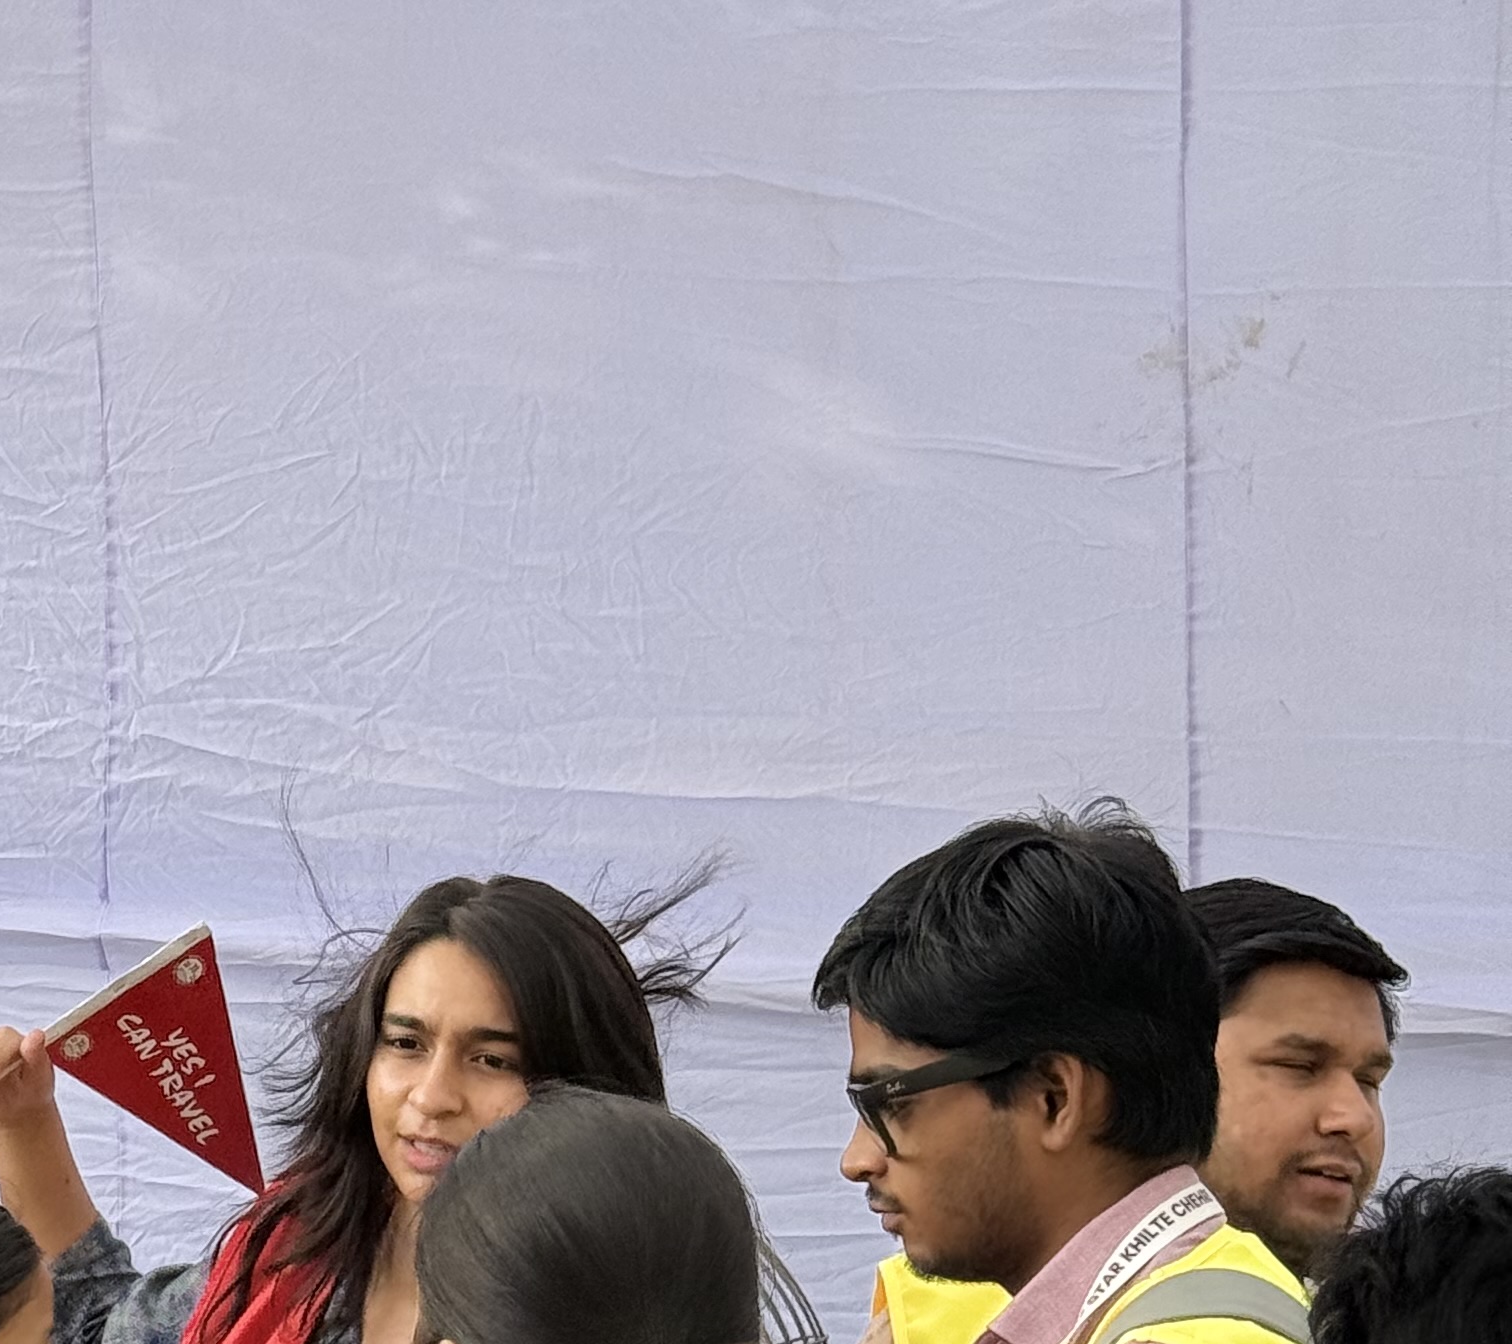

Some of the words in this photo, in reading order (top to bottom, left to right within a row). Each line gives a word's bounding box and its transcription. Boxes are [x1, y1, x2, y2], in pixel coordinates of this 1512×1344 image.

[161, 1027, 206, 1076] YES
[116, 1013, 162, 1061] CAN
[149, 1059, 220, 1146] TRAVEL
[1120, 1210, 1176, 1263] KHILTE
